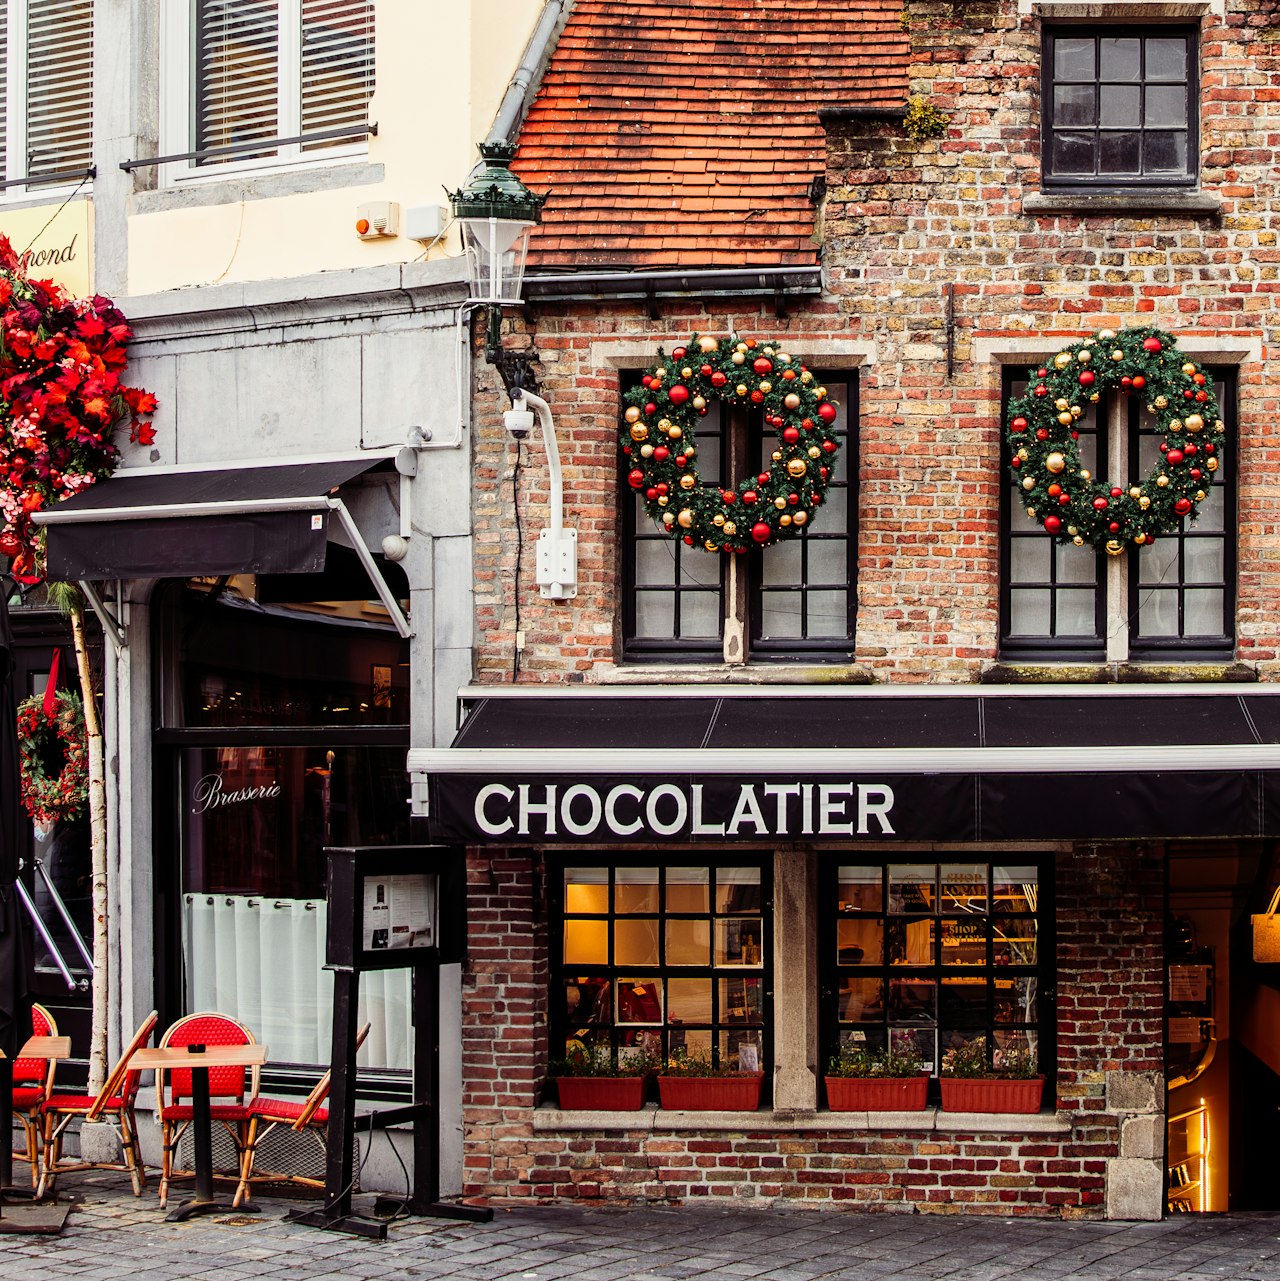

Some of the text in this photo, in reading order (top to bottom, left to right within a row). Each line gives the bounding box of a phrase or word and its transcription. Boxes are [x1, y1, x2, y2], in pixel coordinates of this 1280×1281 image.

[191, 770, 282, 815] Brasserie
[474, 782, 896, 836] CHOCOLATIER
[949, 925, 977, 934] SHOP
